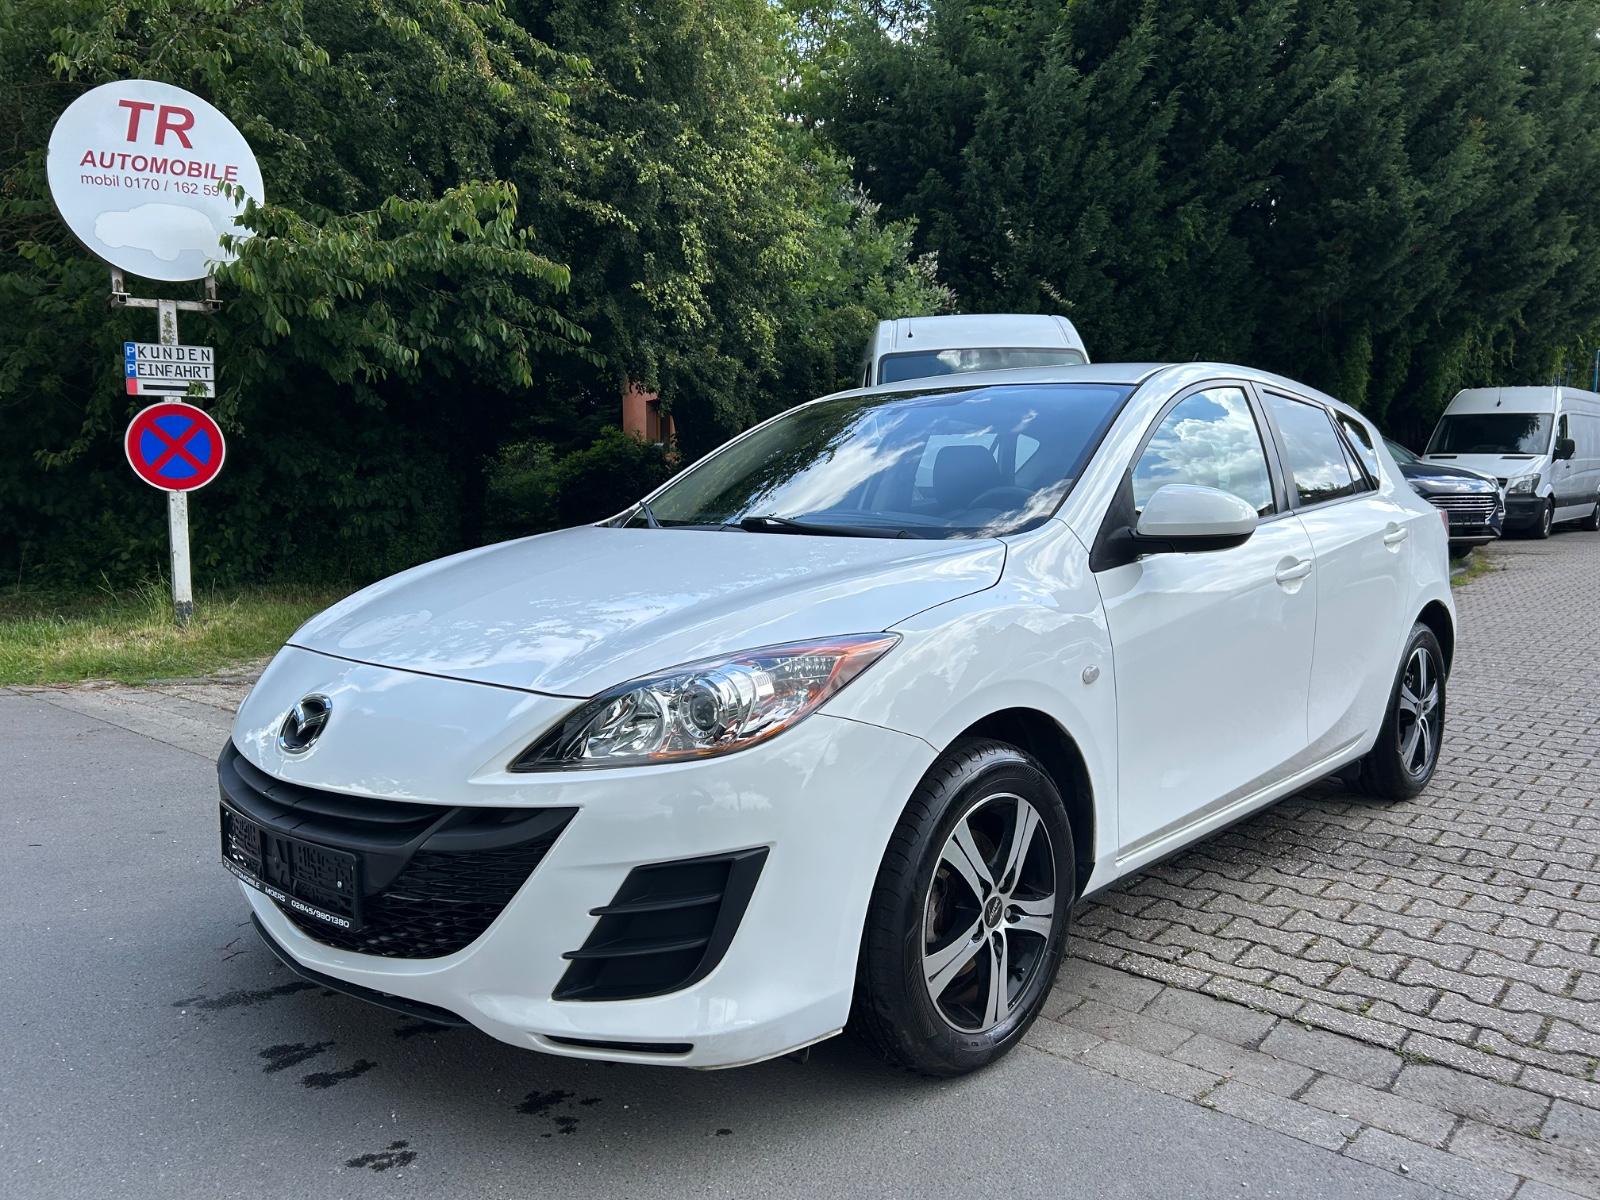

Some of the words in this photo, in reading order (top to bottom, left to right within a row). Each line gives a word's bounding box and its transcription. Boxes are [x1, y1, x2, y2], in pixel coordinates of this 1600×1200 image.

[119, 100, 195, 149] TR
[80, 150, 239, 182] AUTOMOBILE
[80, 173, 119, 187] mobil
[124, 176, 160, 191] 0170
[174, 181, 199, 195] 162
[203, 184, 220, 197] 59
[126, 346, 135, 356] P
[138, 345, 211, 361] KUNDEN
[127, 364, 136, 374] P
[137, 363, 211, 378] EINFAHRT
[265, 886, 286, 902] MOERS
